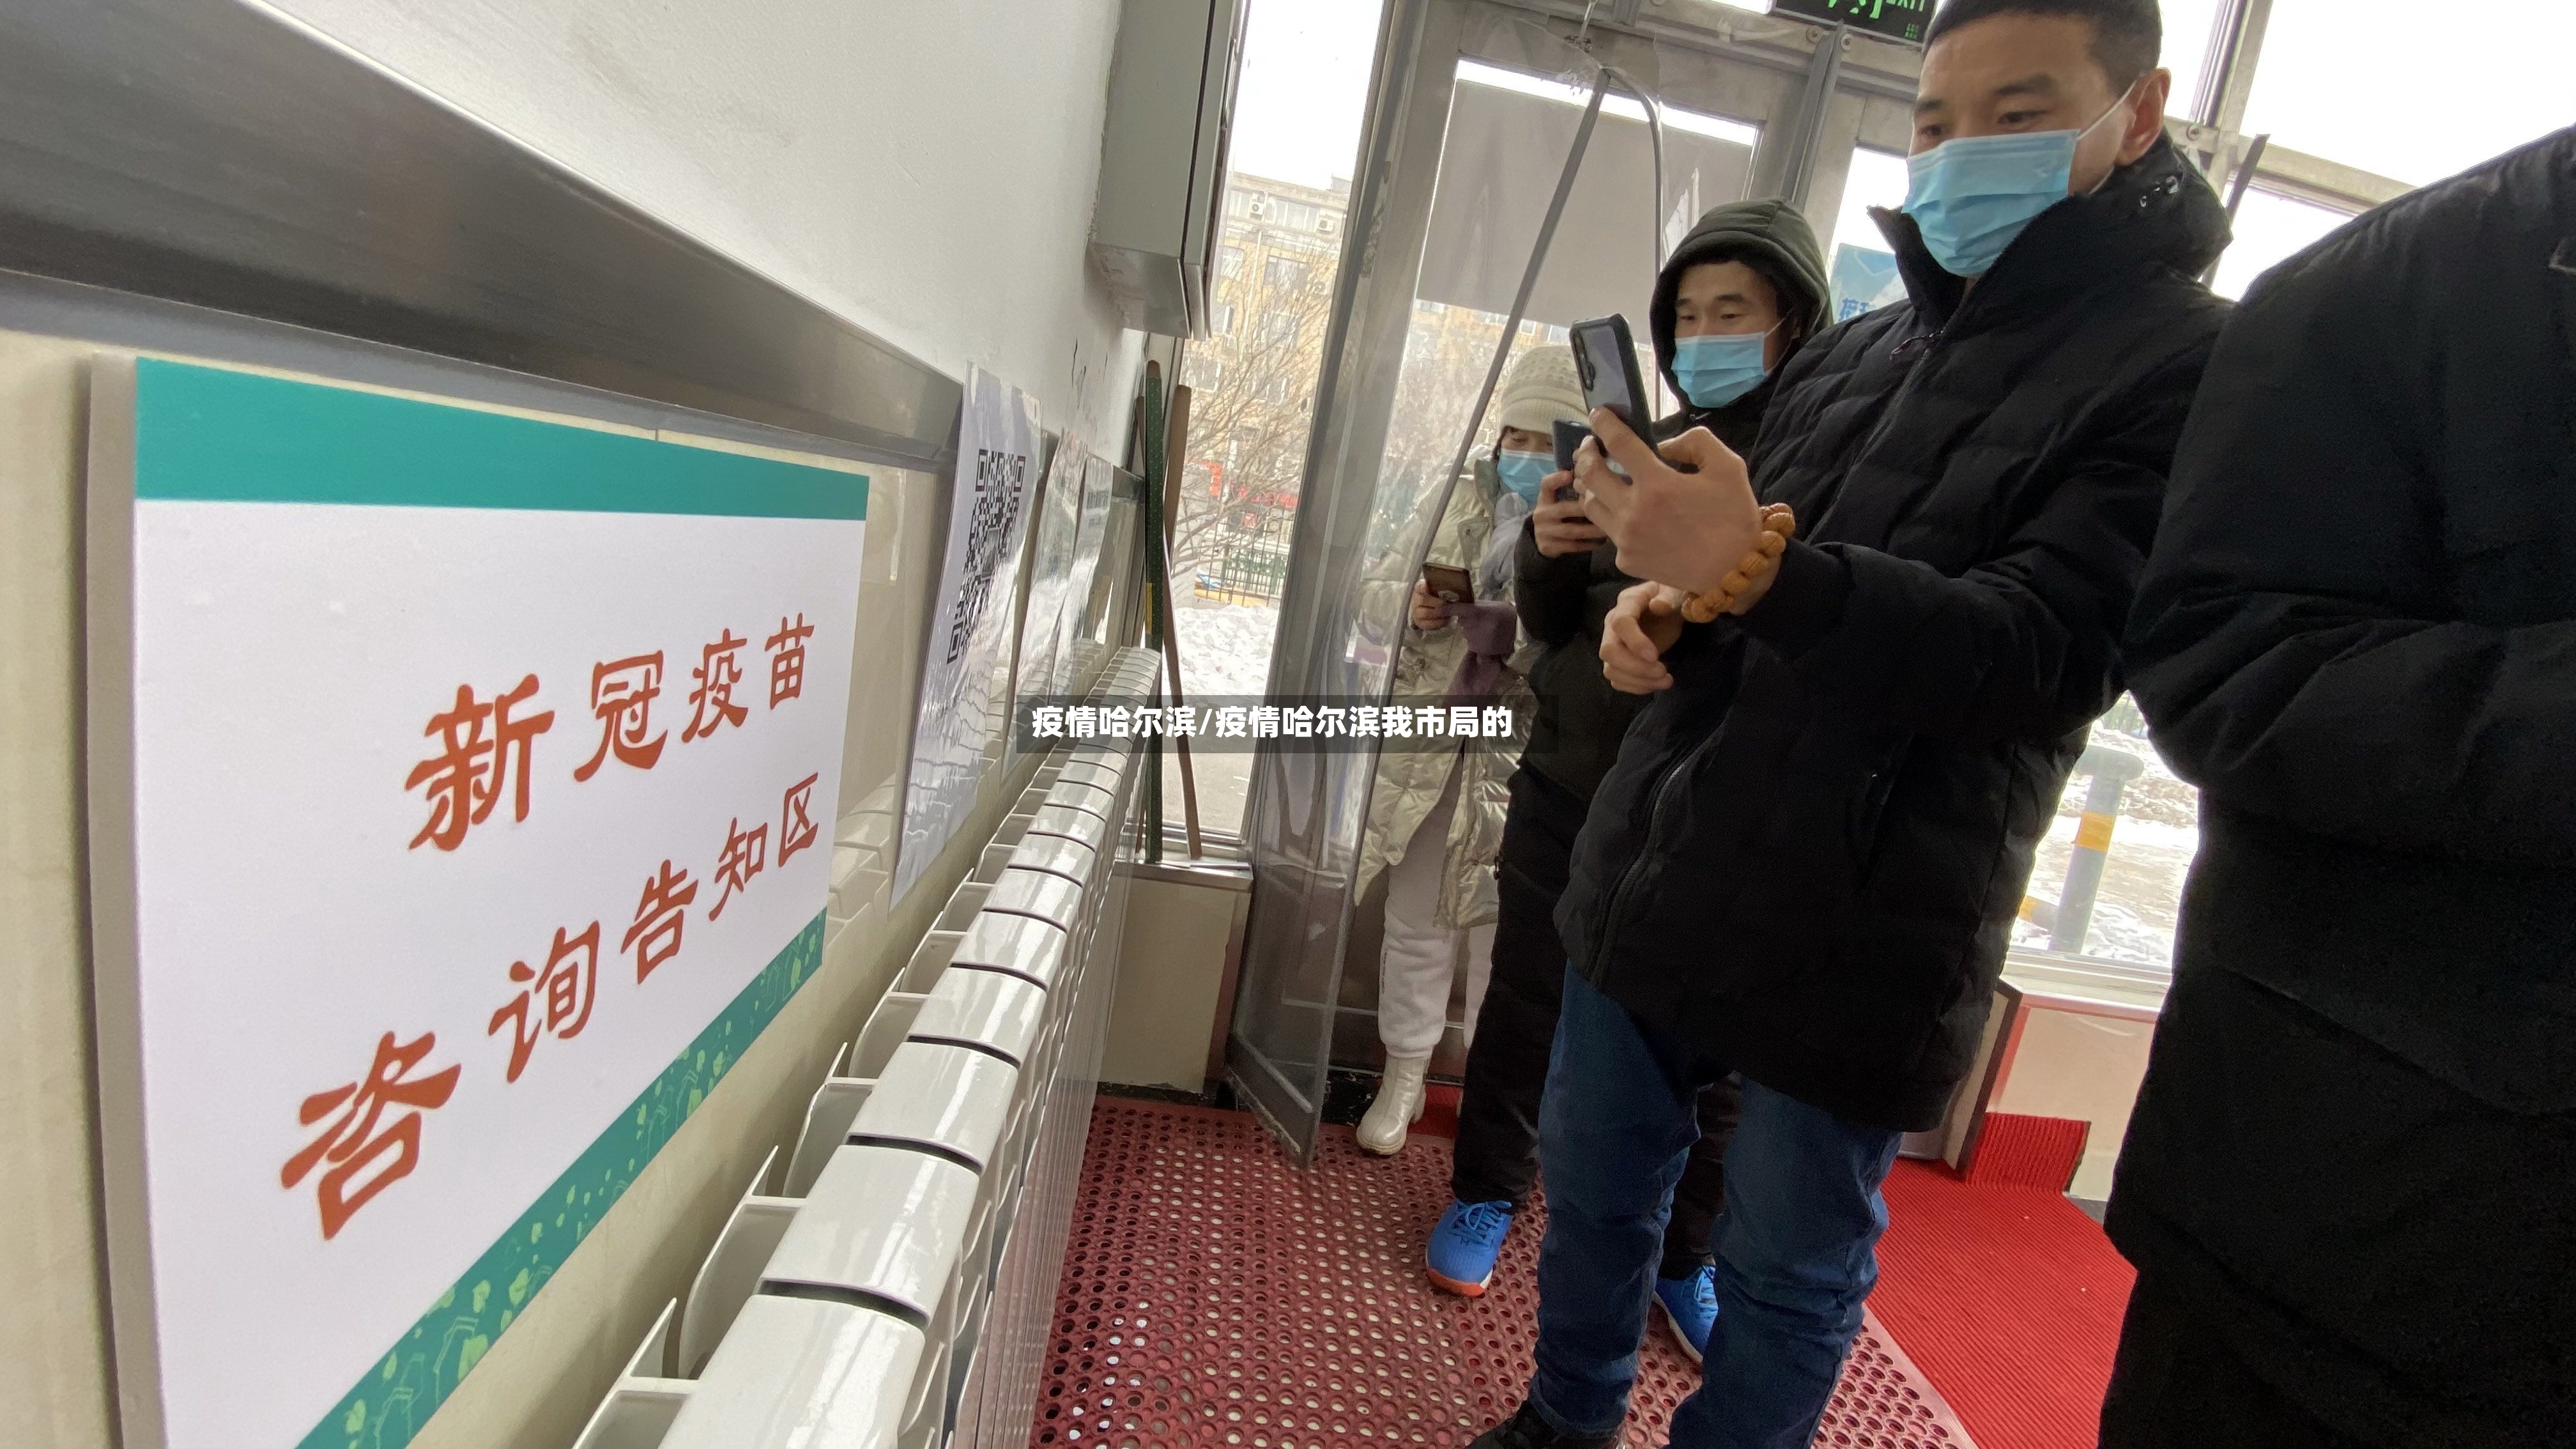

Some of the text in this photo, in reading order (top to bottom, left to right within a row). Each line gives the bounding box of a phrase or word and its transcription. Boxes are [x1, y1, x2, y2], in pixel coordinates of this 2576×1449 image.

[405, 612, 815, 851] 新冠疫苗
[280, 772, 820, 1241] 咨询告知区
